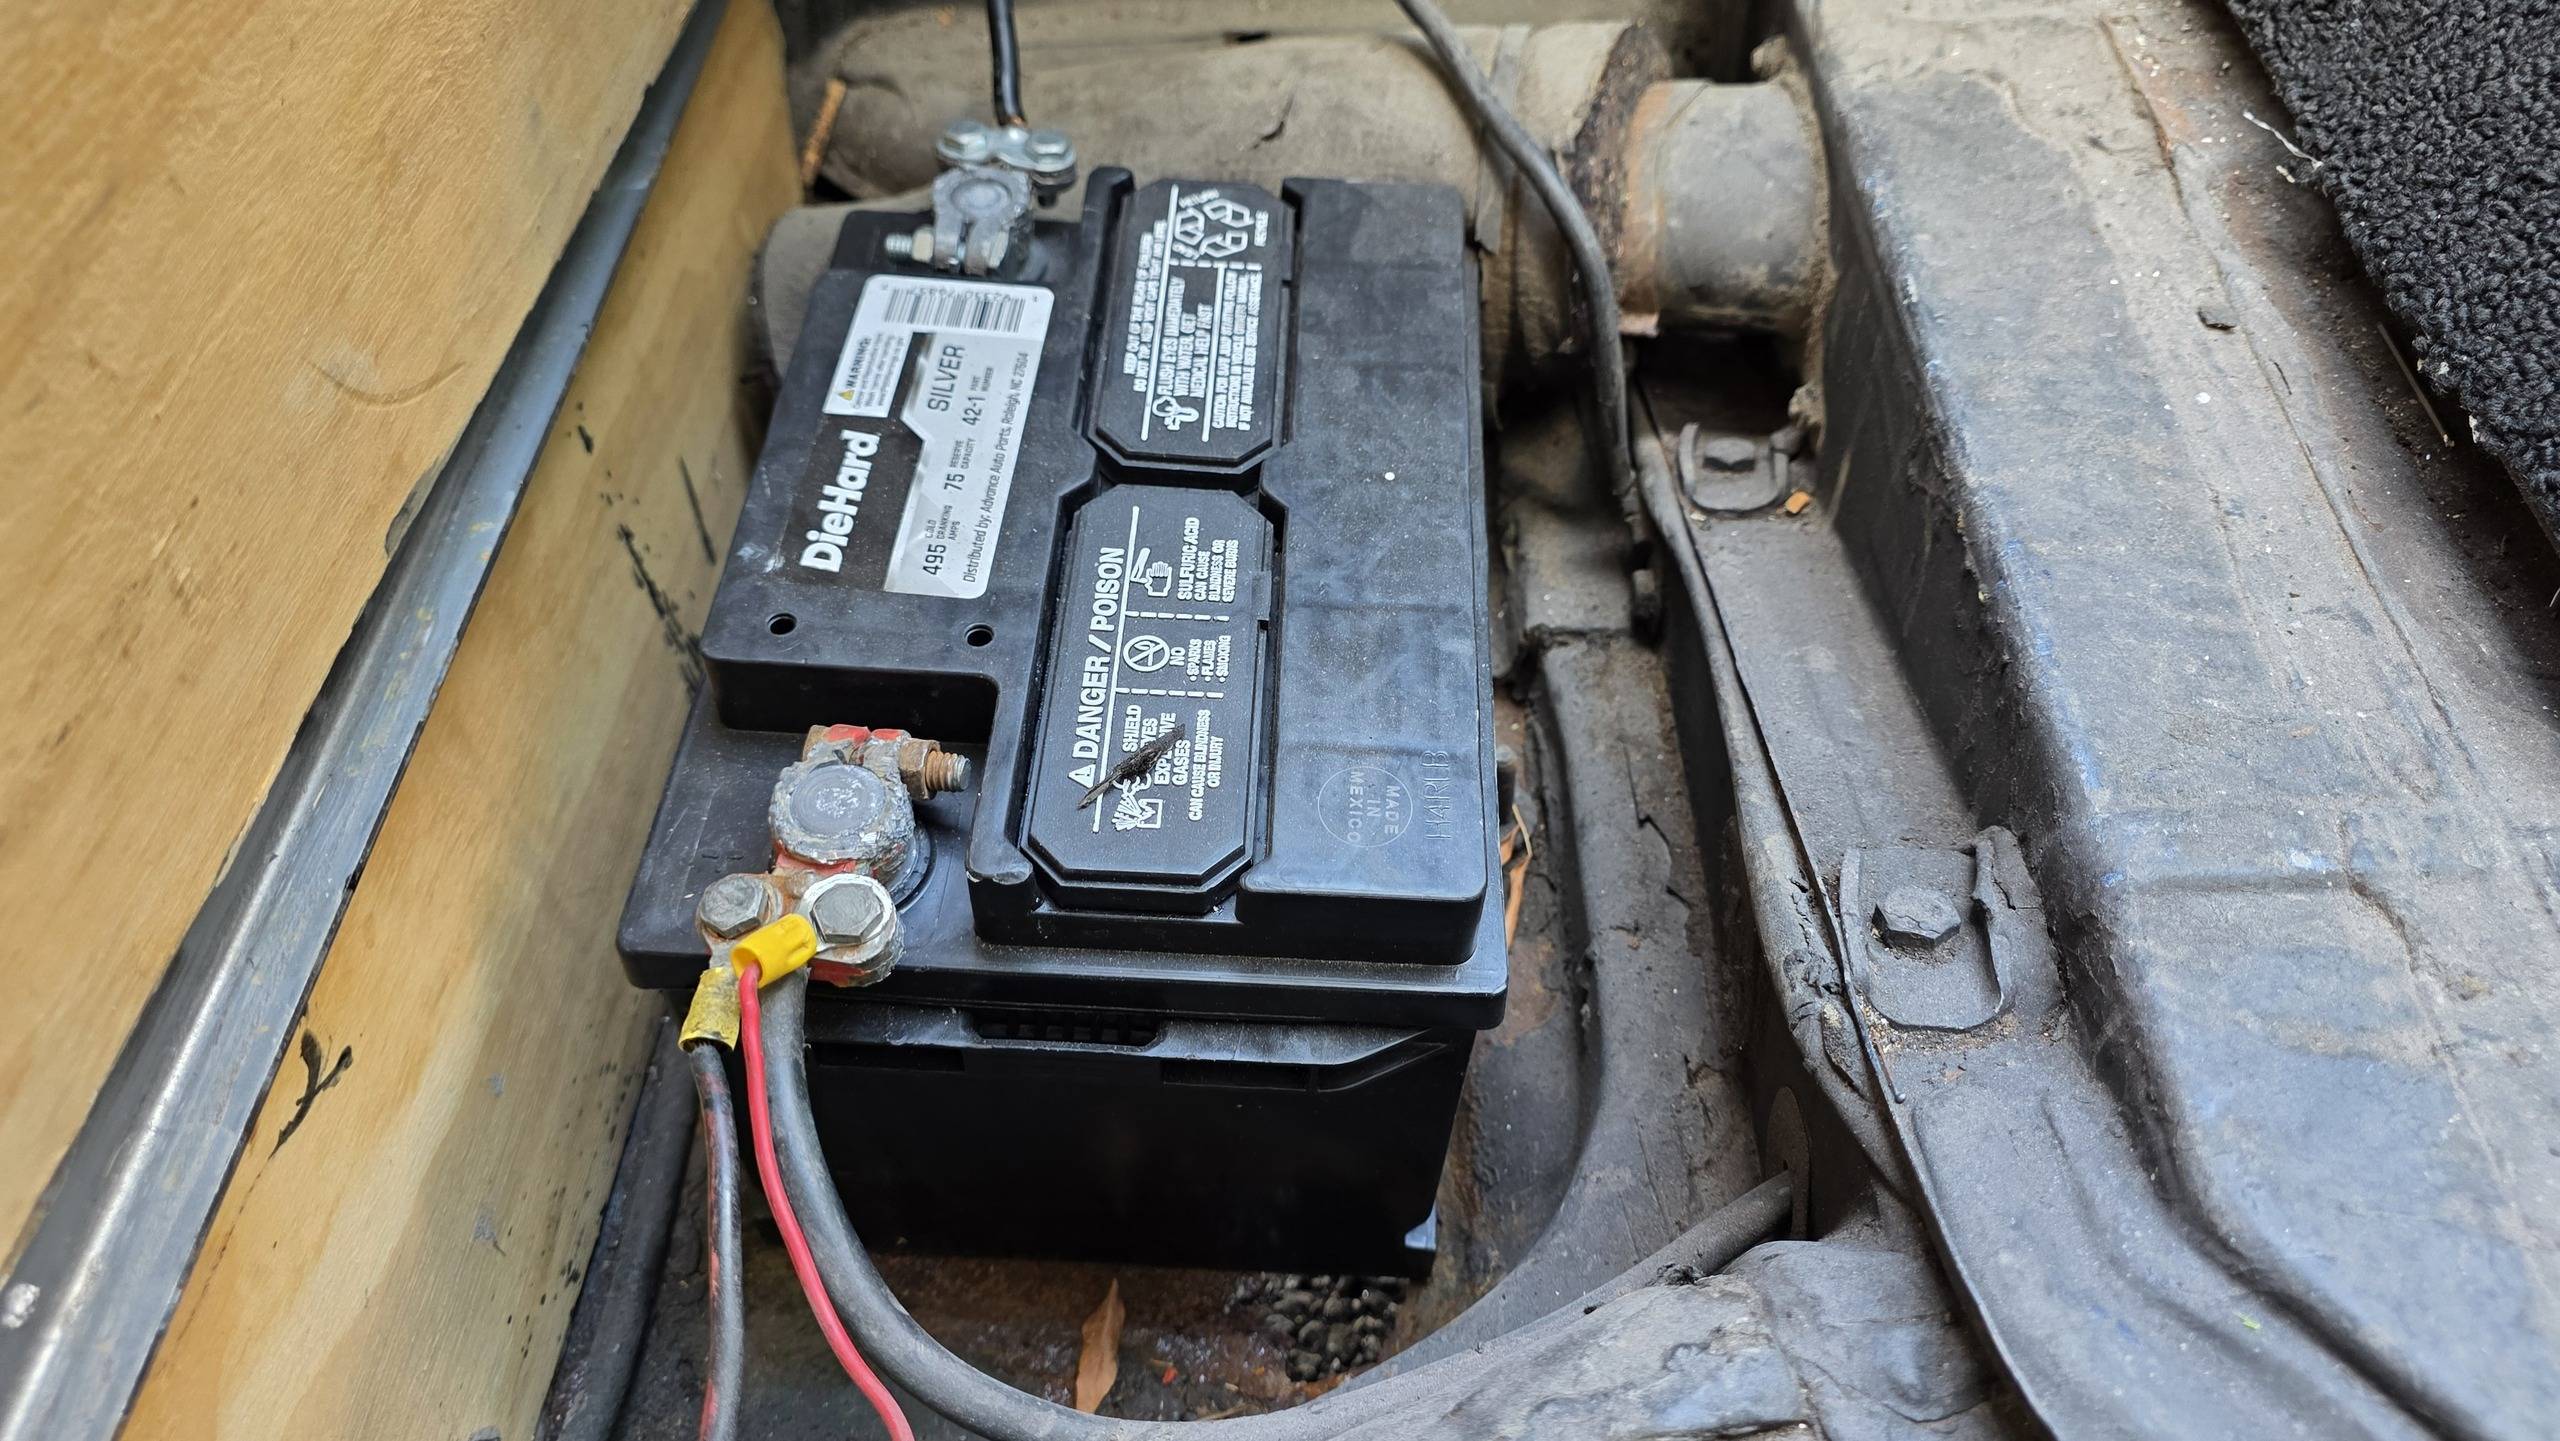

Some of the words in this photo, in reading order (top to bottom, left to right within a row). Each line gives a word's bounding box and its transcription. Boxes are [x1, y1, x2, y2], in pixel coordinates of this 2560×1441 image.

[1164, 276, 1185, 337] IMMEDIATELY
[1180, 311, 1196, 334] GET
[1196, 303, 1213, 329] FAST
[1160, 337, 1177, 363] EYES
[1193, 329, 1210, 355] HELP
[927, 345, 965, 412] SILVER
[1011, 379, 1023, 390] NC
[1157, 363, 1175, 395] FLUSH
[1173, 371, 1190, 396] WITH
[1190, 356, 1208, 398] MEDICAL
[962, 397, 986, 425] 42-1
[961, 438, 976, 469] CAPACITY
[989, 453, 1006, 473] Auto
[944, 473, 965, 491] 75
[980, 475, 1000, 512] Advance
[799, 430, 881, 572] DieHard
[948, 521, 961, 540] AMPS
[1183, 517, 1200, 544] ACID
[1211, 539, 1225, 553] OR
[923, 544, 947, 575] 495
[963, 530, 986, 582] Distributed
[1196, 550, 1211, 579] CAUSE
[1226, 539, 1239, 568] BURNS
[1177, 544, 1197, 600] SULFURIC
[1208, 554, 1224, 601] BLINDNESS
[1223, 569, 1237, 602] SEVERE
[1090, 547, 1124, 631] POISON
[1195, 581, 1207, 600] CAN
[1088, 634, 1111, 653] /
[1170, 647, 1185, 666] NO
[1187, 638, 1202, 675] SPARKS
[1201, 640, 1216, 675] FLAMES
[1216, 635, 1231, 677] SMOKING
[1072, 656, 1111, 759] DANGER
[1122, 705, 1142, 751] SHIELD
[1140, 718, 1158, 750] YES
[1193, 709, 1211, 763] BLINDNESS
[1154, 713, 1176, 785] EXPLIVE
[1172, 740, 1191, 785] GASES
[1208, 736, 1224, 770] INJURY
[1191, 763, 1206, 798] CAUSE
[1207, 771, 1221, 787] OR
[1188, 798, 1203, 821] CAN
[1347, 772, 1365, 842] MEXICO
[1366, 800, 1381, 817] IN
[1385, 785, 1400, 834] MADE
